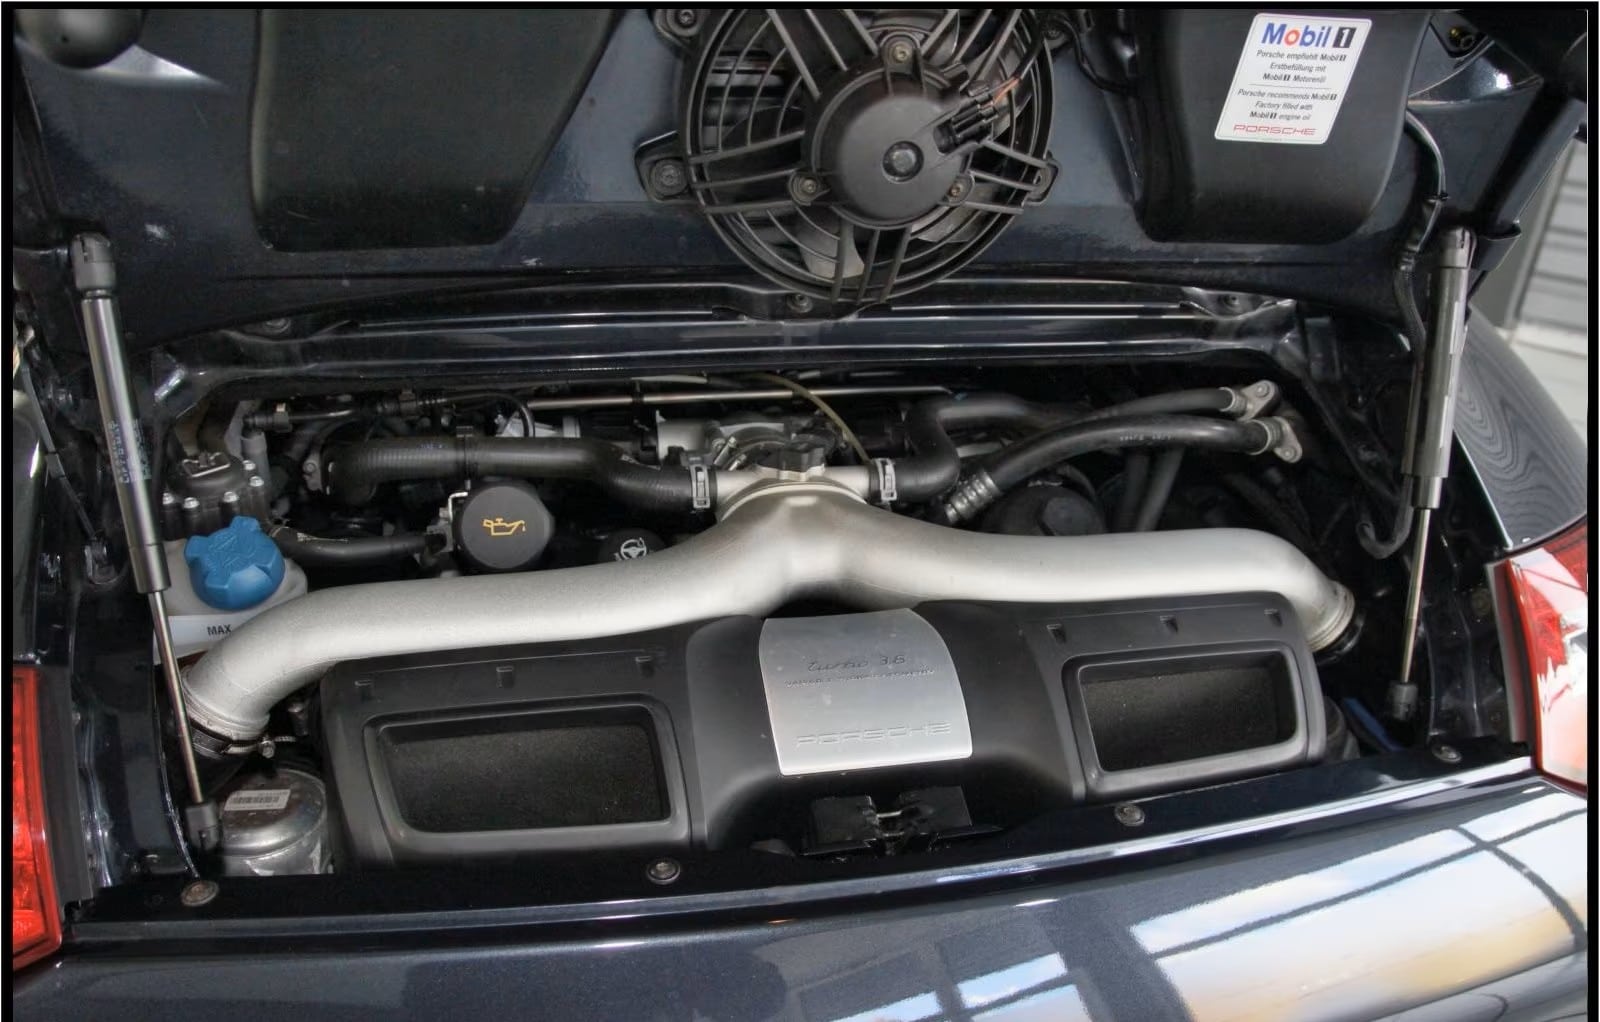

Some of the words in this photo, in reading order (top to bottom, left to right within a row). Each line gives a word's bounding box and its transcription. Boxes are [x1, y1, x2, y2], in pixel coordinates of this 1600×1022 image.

[1261, 22, 1332, 47] Mobil
[1256, 49, 1285, 58] Porsche
[1237, 88, 1266, 98] Porsche
[1267, 92, 1310, 100] recommends
[1255, 101, 1280, 110] Factory
[1279, 113, 1302, 121] engine
[1233, 124, 1317, 135] PORSCHE
[206, 624, 233, 636] MAX
[797, 722, 951, 747] PORSCHE
